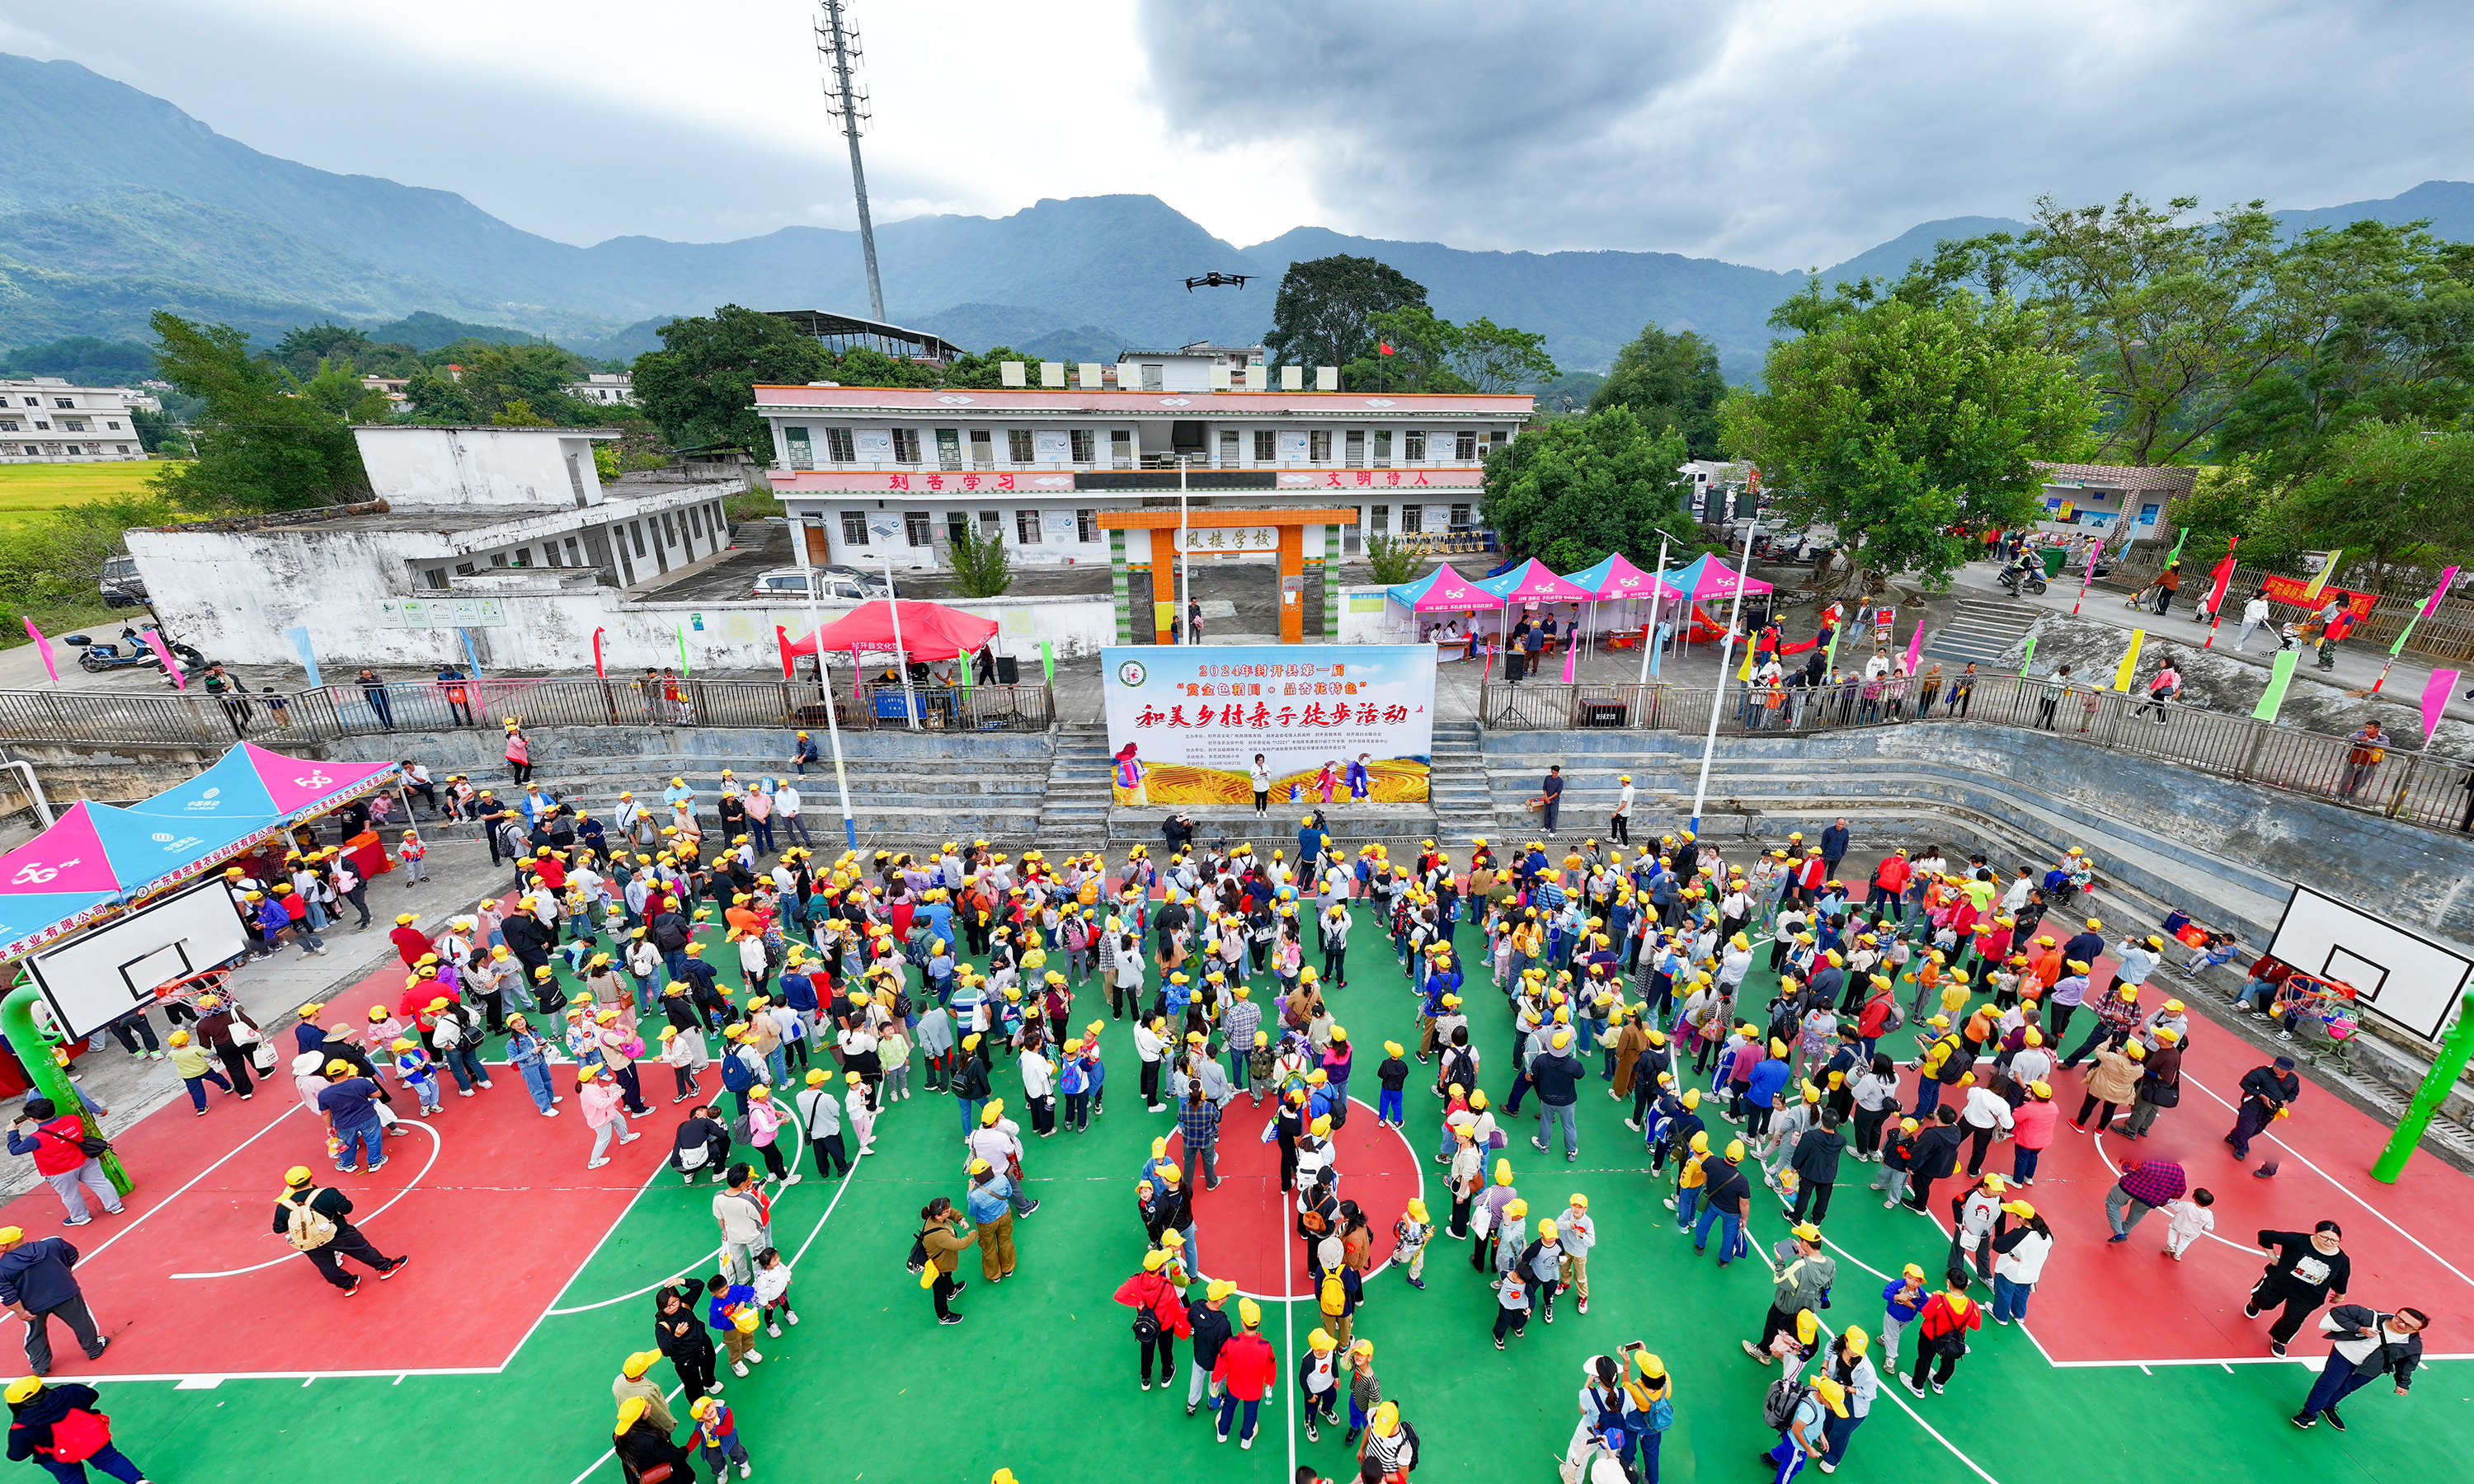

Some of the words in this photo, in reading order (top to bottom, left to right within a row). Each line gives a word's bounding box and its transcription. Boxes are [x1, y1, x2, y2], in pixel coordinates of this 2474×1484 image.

[889, 473, 1014, 491] 刻苦学习
[1327, 471, 1428, 486] 文明待人
[1185, 528, 1271, 549] 凤楼学校
[1199, 663, 1345, 678] 2024年封开县第一届
[1135, 702, 1409, 729] 和美乡村亲子徒步活动
